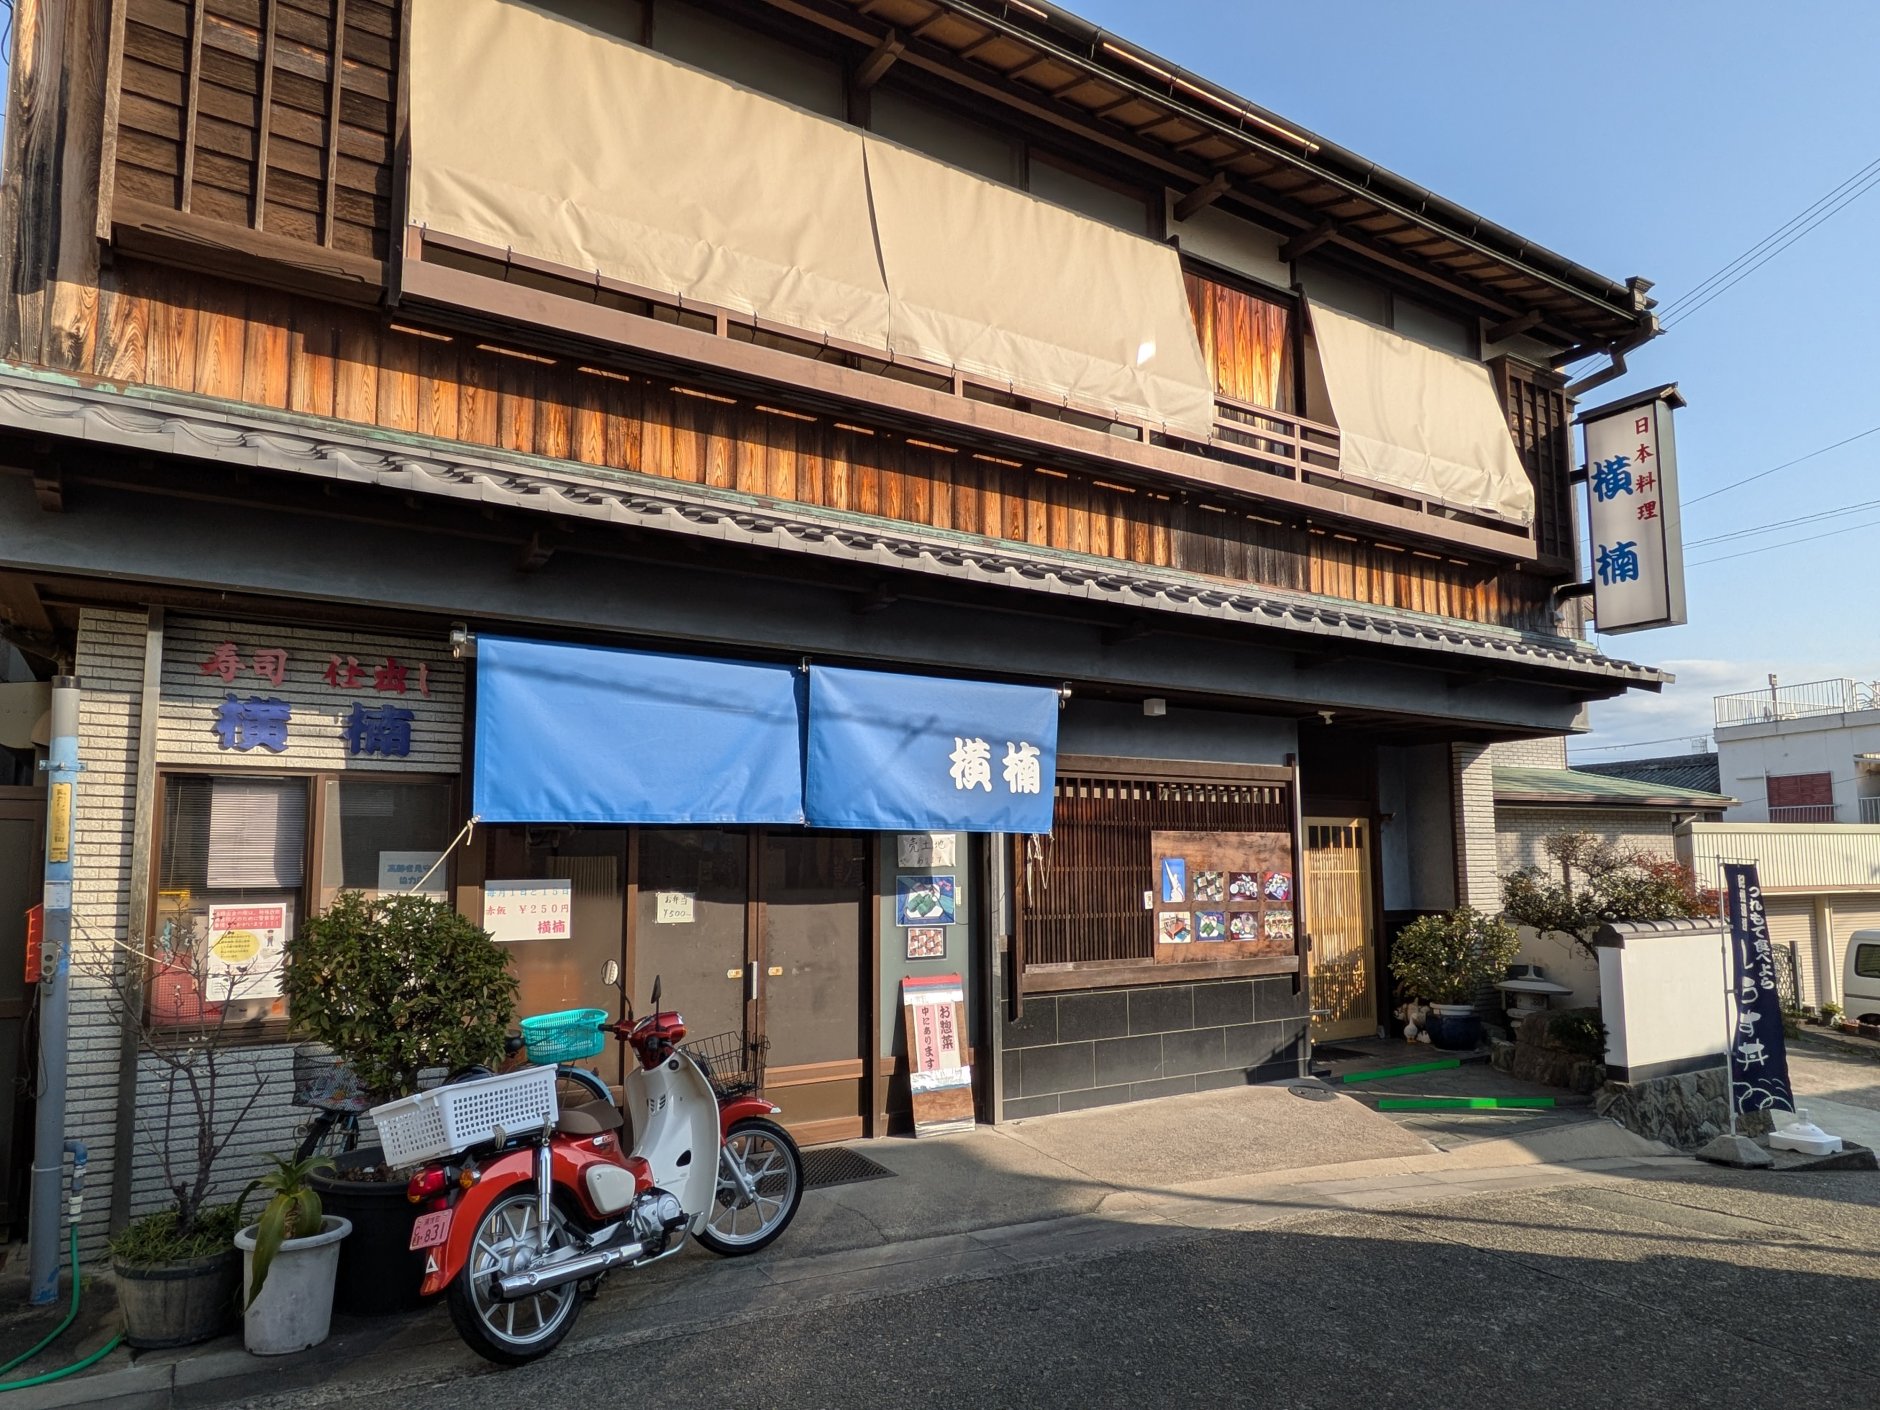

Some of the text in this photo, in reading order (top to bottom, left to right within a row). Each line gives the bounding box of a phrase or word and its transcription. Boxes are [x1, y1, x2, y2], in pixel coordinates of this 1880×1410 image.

[1633, 416, 1659, 521] 日本料理
[1591, 455, 1639, 586] 横楠
[200, 640, 431, 698] 寿司 仕出し
[949, 737, 1042, 794] 横楠
[486, 905, 507, 916] 赤飯
[537, 920, 566, 934] 横楠
[664, 895, 688, 905] お弁当
[1748, 886, 1775, 990] つれもて食べよら
[939, 1005, 954, 1050] お惣菜
[1736, 939, 1769, 1072] しらす丼
[921, 1006, 935, 1070] 中にあります
[424, 1221, 446, 1243] 831
